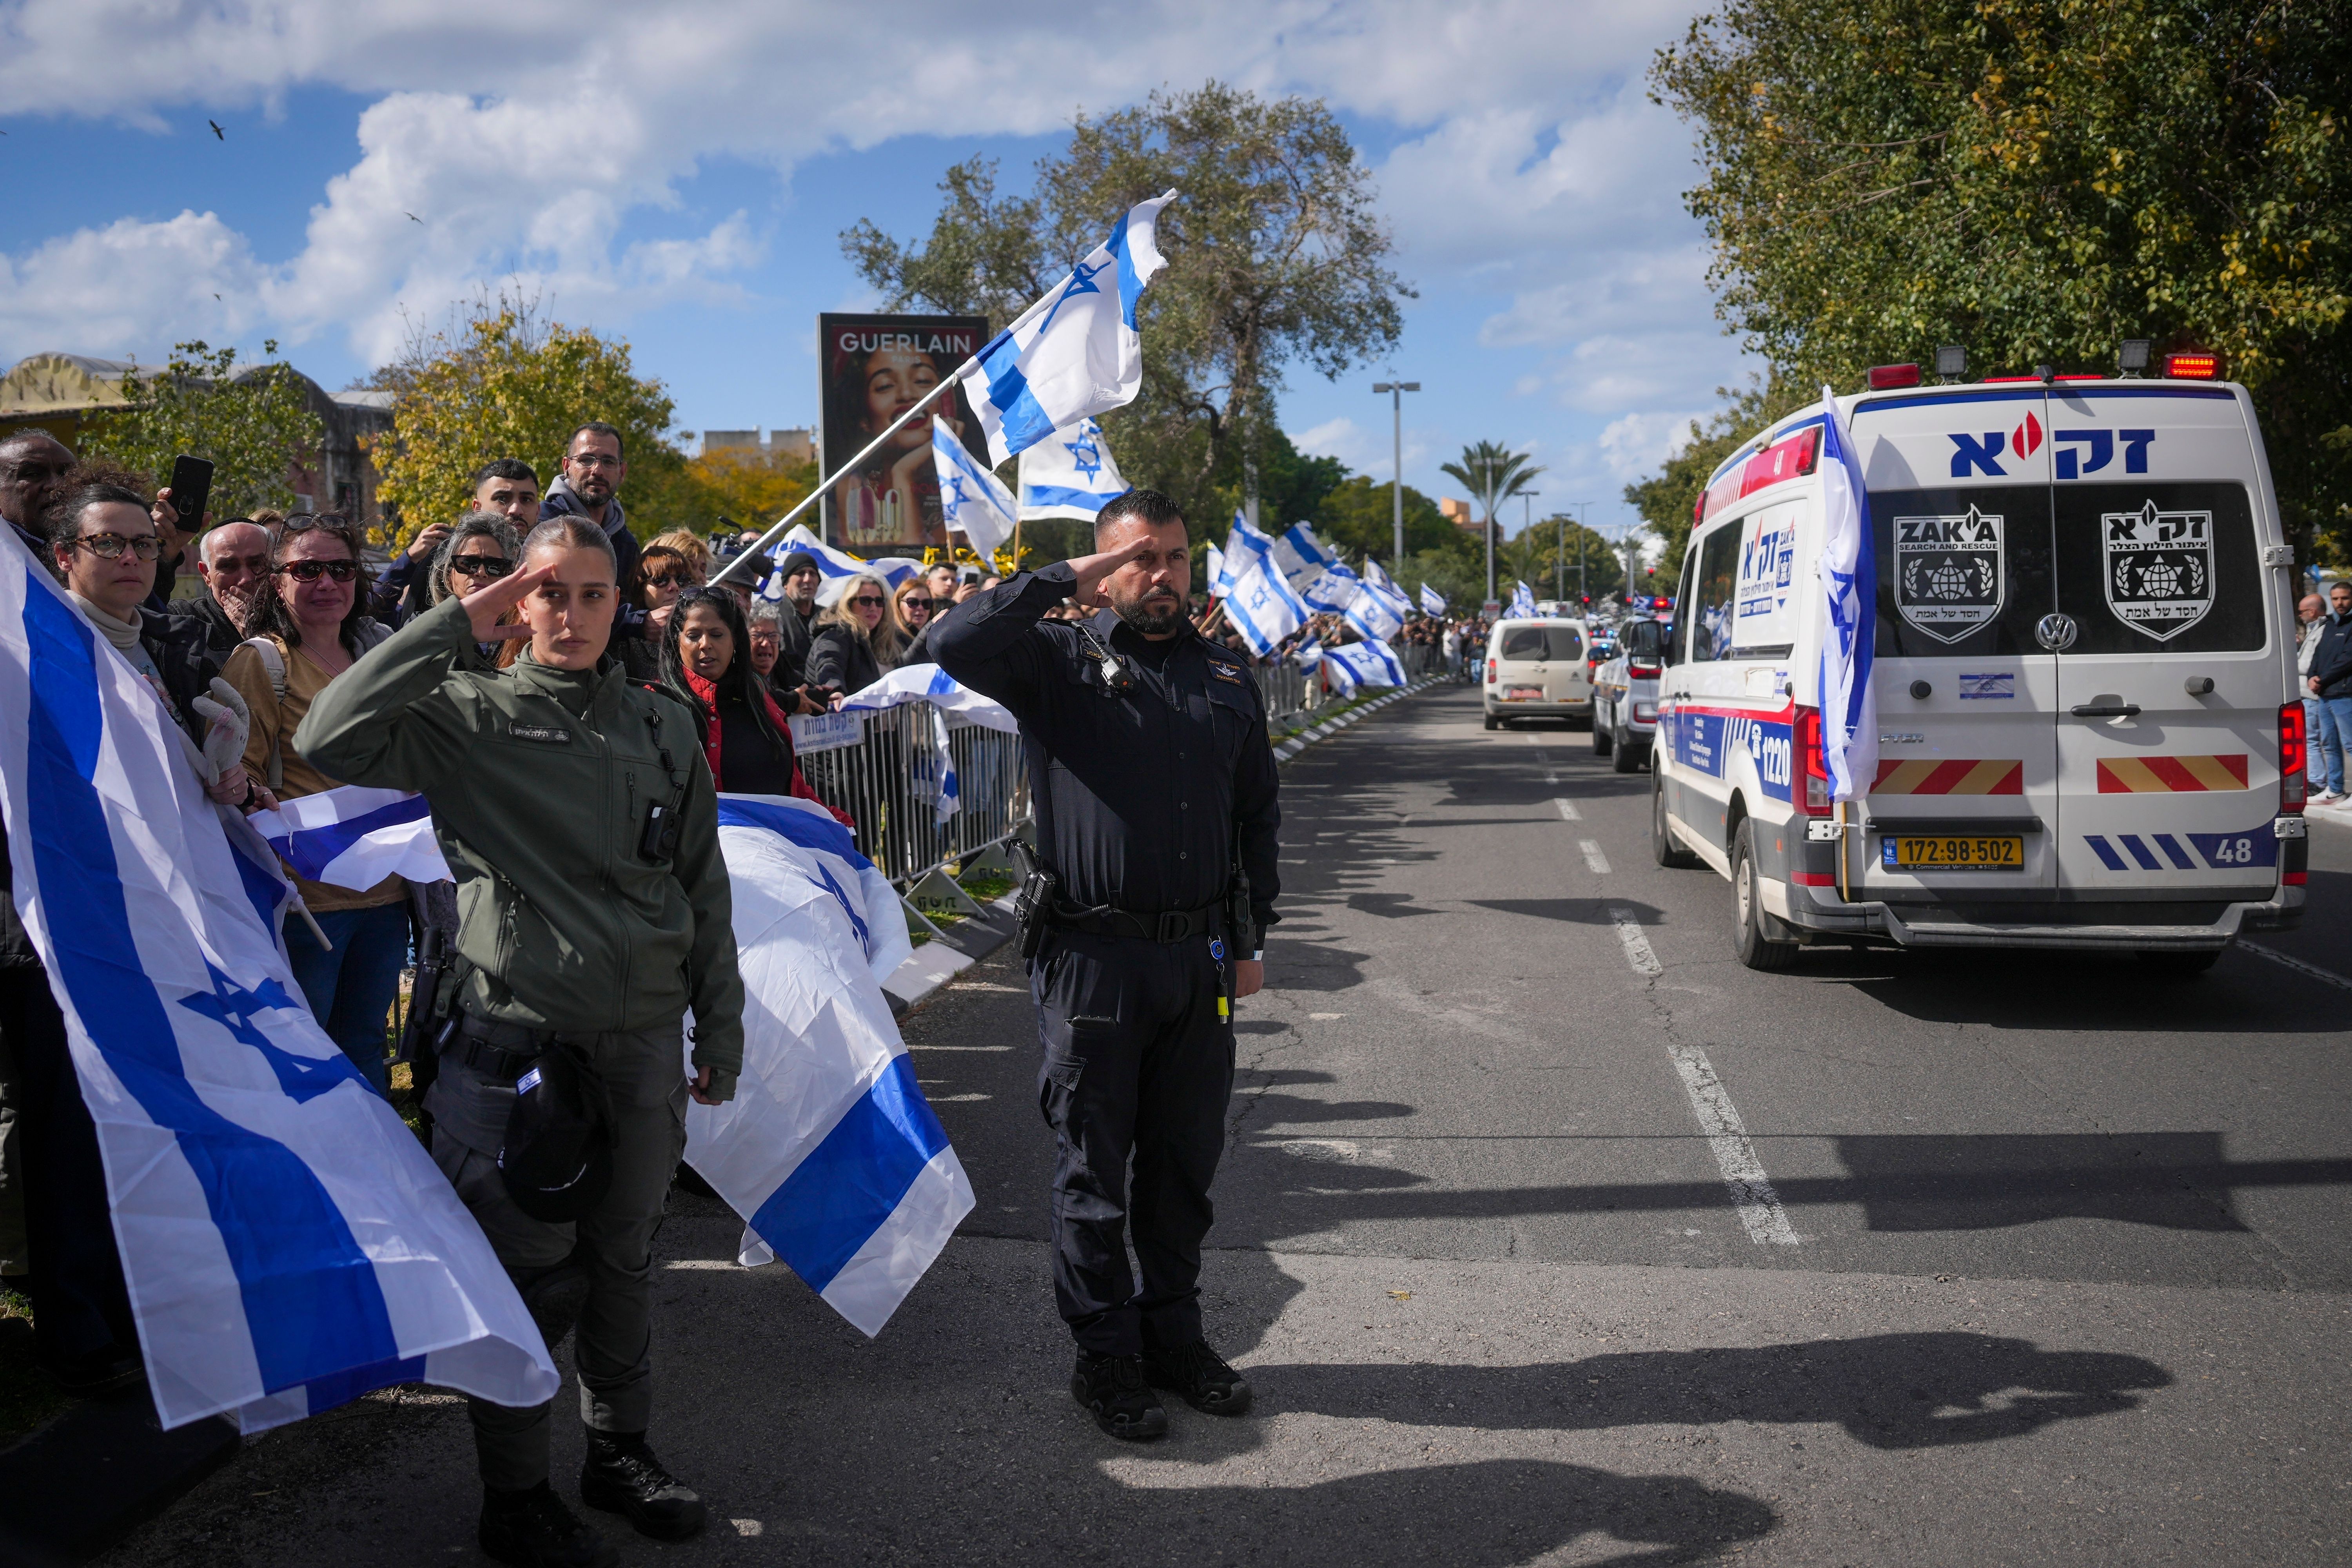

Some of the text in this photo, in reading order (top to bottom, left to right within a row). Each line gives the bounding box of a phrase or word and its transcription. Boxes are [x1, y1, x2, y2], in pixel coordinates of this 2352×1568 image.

[839, 332, 971, 354] GUERLAIN
[1773, 449, 1784, 475] 48
[2143, 541, 2173, 550] חילוץ
[1941, 608, 1956, 618] של
[2126, 603, 2198, 618] חסד של אמת
[1880, 733, 1924, 743] FTER
[1762, 736, 1791, 787] 1220
[2216, 838, 2252, 862] 48
